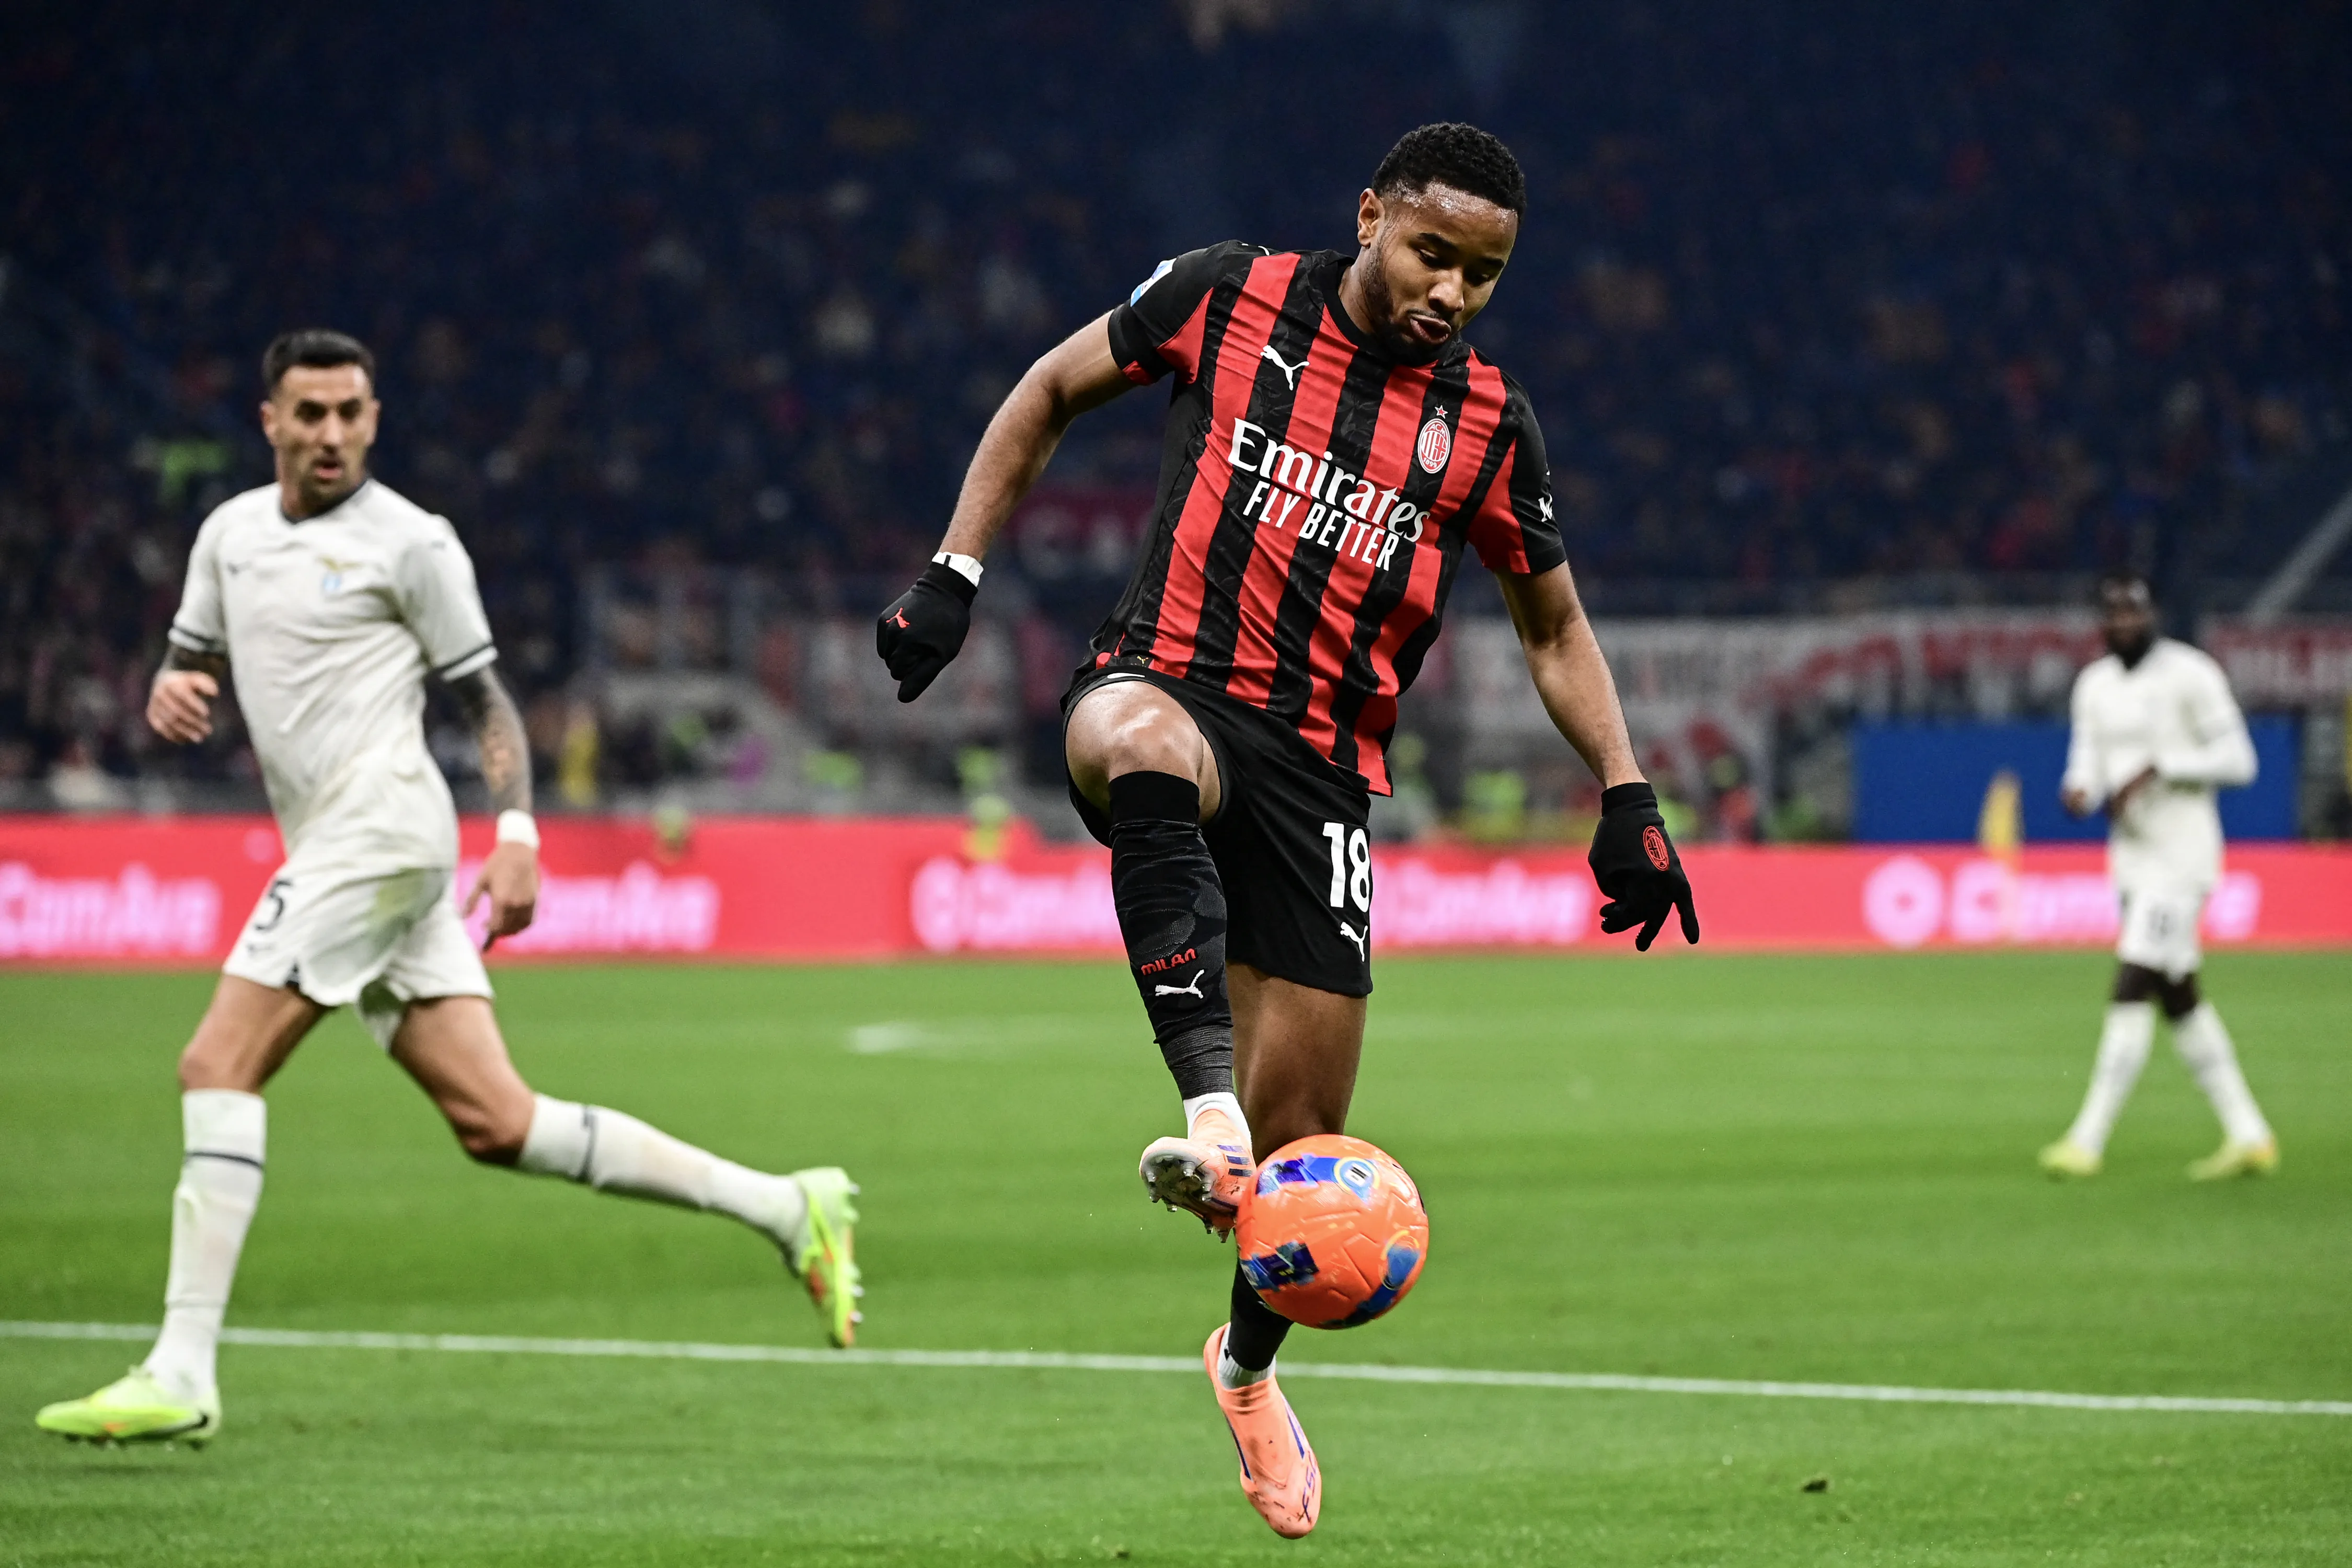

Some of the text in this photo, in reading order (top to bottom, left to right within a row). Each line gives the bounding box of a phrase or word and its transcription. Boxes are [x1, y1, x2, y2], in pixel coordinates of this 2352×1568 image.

[1423, 457, 1438, 468] 1899
[1428, 423, 1446, 437] ACM
[1228, 417, 1431, 543] Emirates
[1242, 480, 1400, 571] FLY BETTER
[1322, 822, 1370, 913] 18
